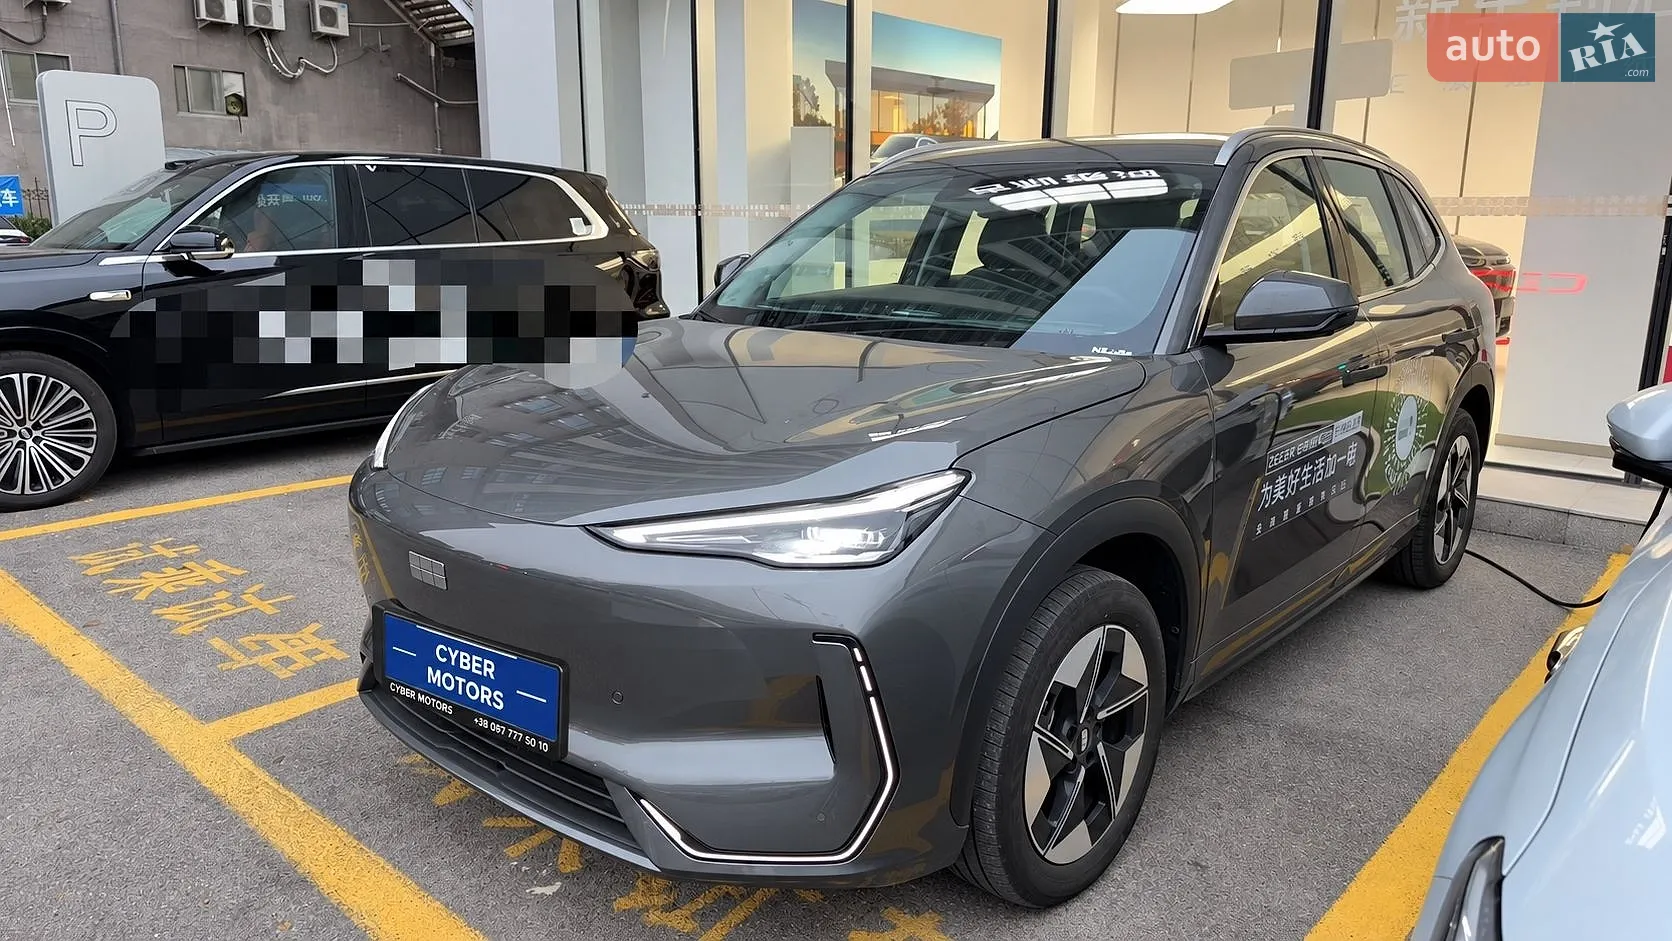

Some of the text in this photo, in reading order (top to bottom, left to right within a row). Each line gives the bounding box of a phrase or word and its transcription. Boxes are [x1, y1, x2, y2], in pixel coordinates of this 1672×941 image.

[65, 99, 118, 167] P
[0, 188, 20, 207] 车
[435, 644, 496, 680] CYBER
[389, 682, 453, 715] CYBER MOTORS
[427, 666, 504, 710] MOTORS
[473, 717, 489, 729] +38
[508, 729, 523, 742] 777
[525, 736, 536, 748] 50
[539, 740, 549, 753] 10
